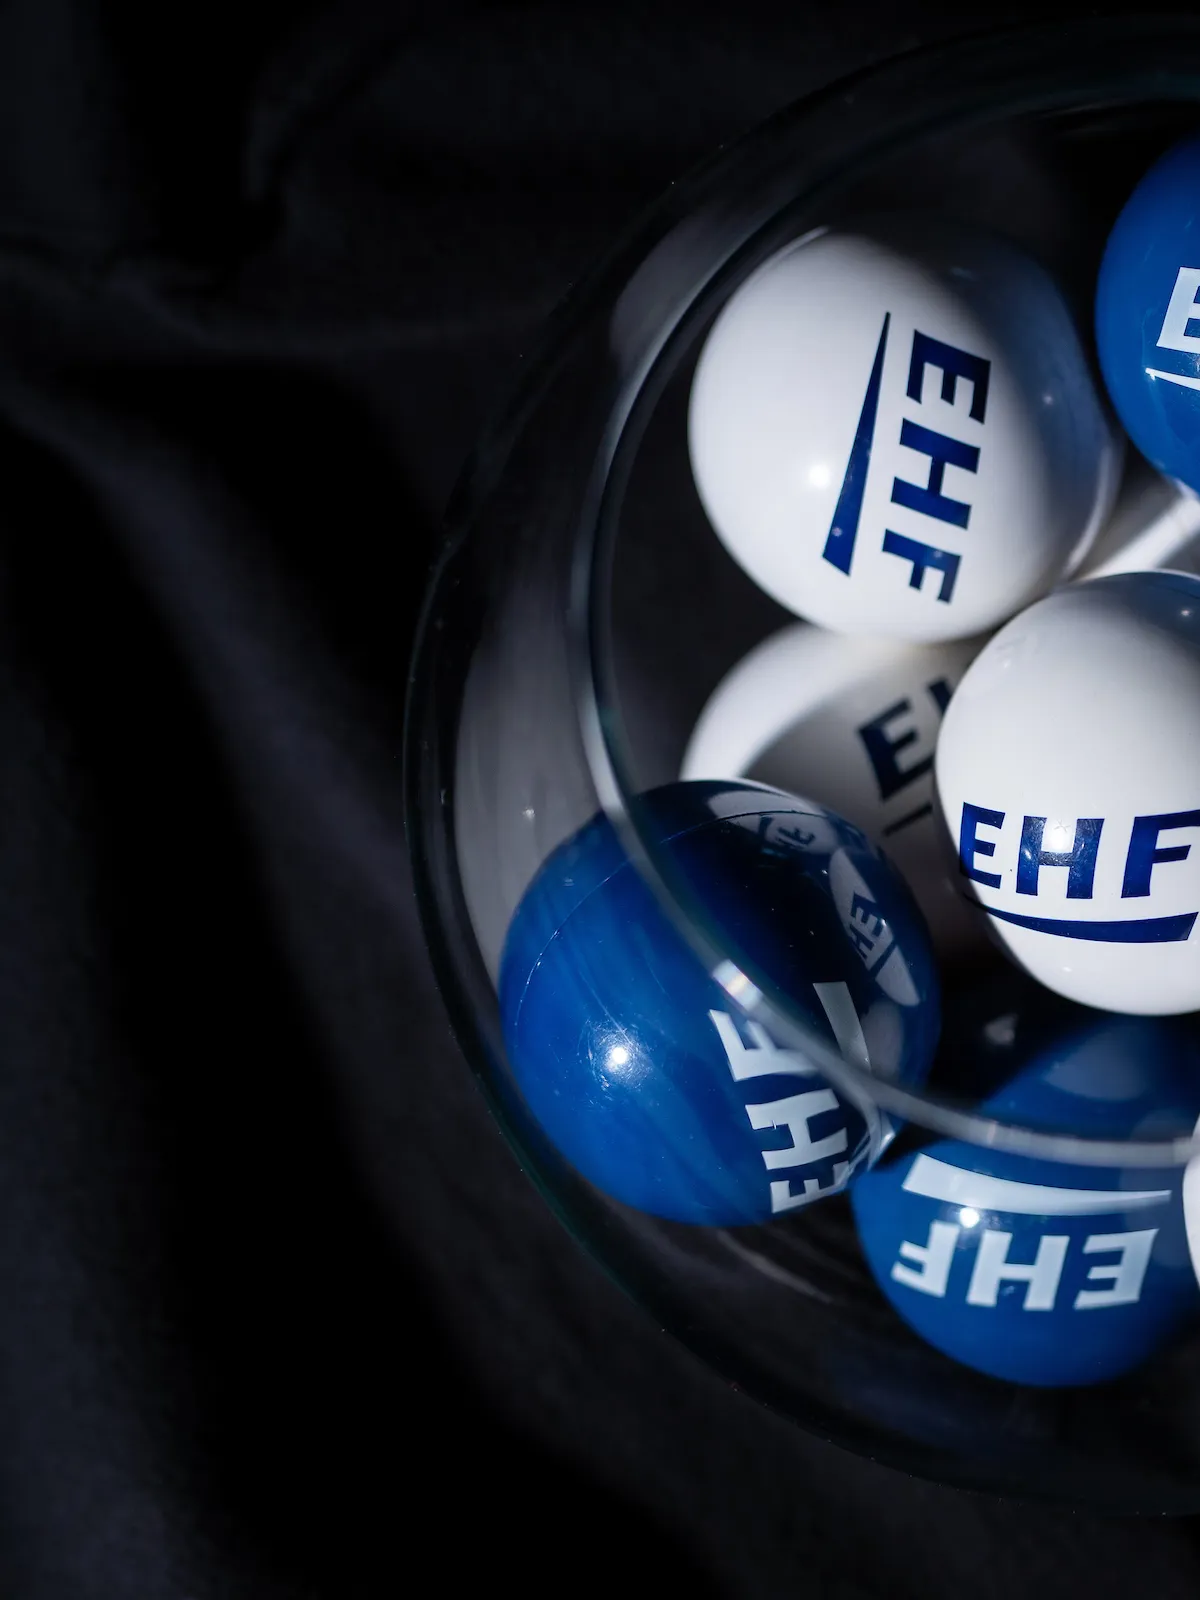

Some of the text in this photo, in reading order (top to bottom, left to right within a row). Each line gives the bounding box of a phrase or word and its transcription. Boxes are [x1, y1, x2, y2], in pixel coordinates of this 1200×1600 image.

[882, 329, 992, 603] EHF
[708, 1009, 850, 1213] EHF
[891, 1220, 1160, 1312] EHF
